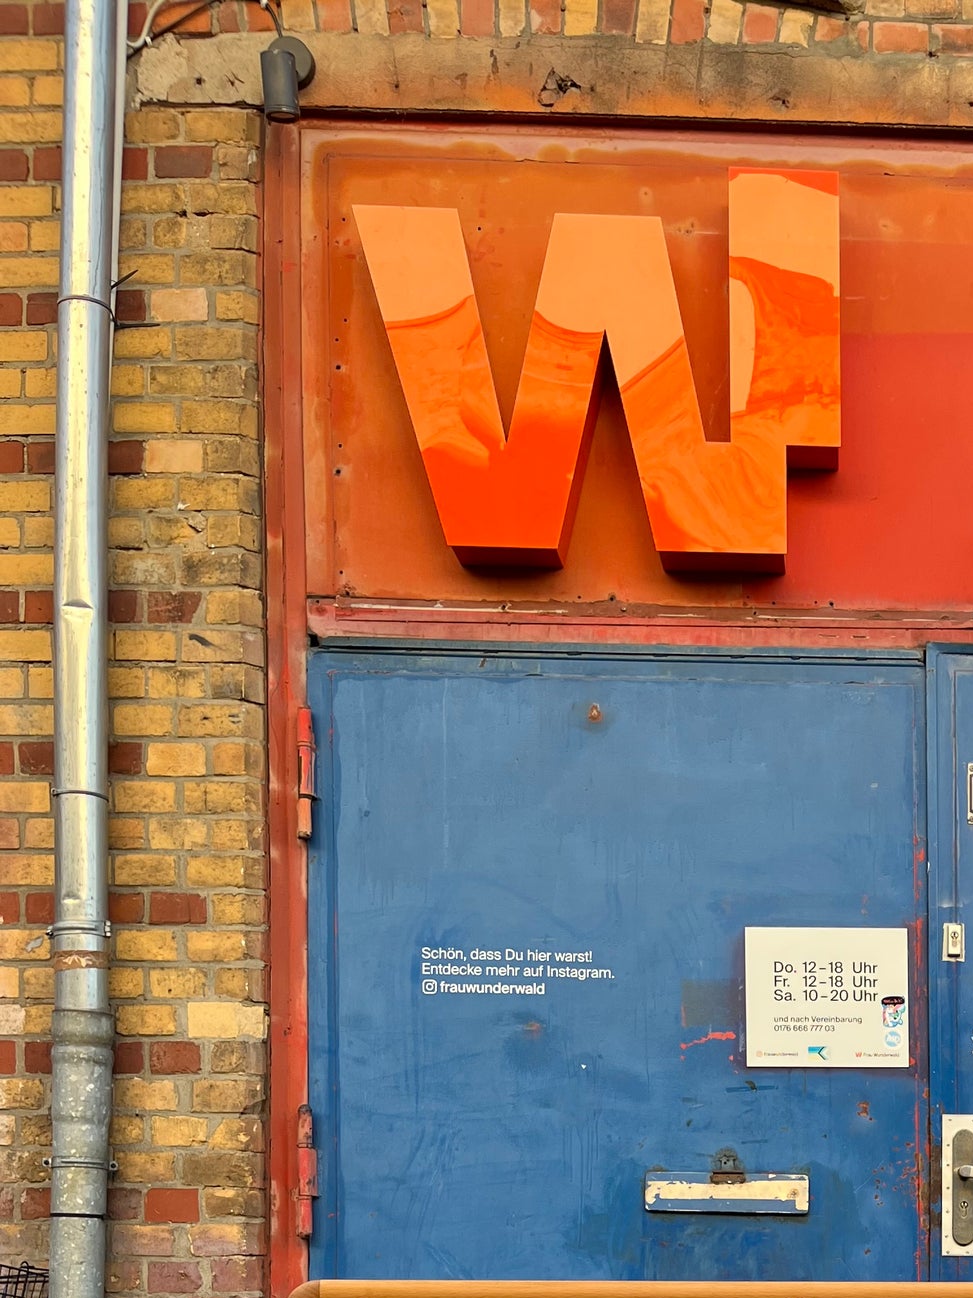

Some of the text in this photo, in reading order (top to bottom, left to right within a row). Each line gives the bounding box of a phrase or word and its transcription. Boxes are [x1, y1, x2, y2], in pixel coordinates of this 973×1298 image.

[421, 947, 593, 963] Schön, dass Du hier warst!
[421, 962, 615, 981] Entdecke mehr auf Instagram.
[773, 961, 797, 974] Do.
[852, 961, 878, 974] Uhr
[440, 980, 545, 995] frauwunderwald
[773, 975, 791, 988] Fr.
[852, 975, 878, 988] Uhr
[773, 989, 797, 1002] Sa.
[852, 989, 878, 1002] Uhr
[773, 1015, 863, 1025] und nach Vereinbarung
[773, 1024, 792, 1032] 0176
[810, 1024, 823, 1032] 777
[824, 1024, 836, 1032] 03
